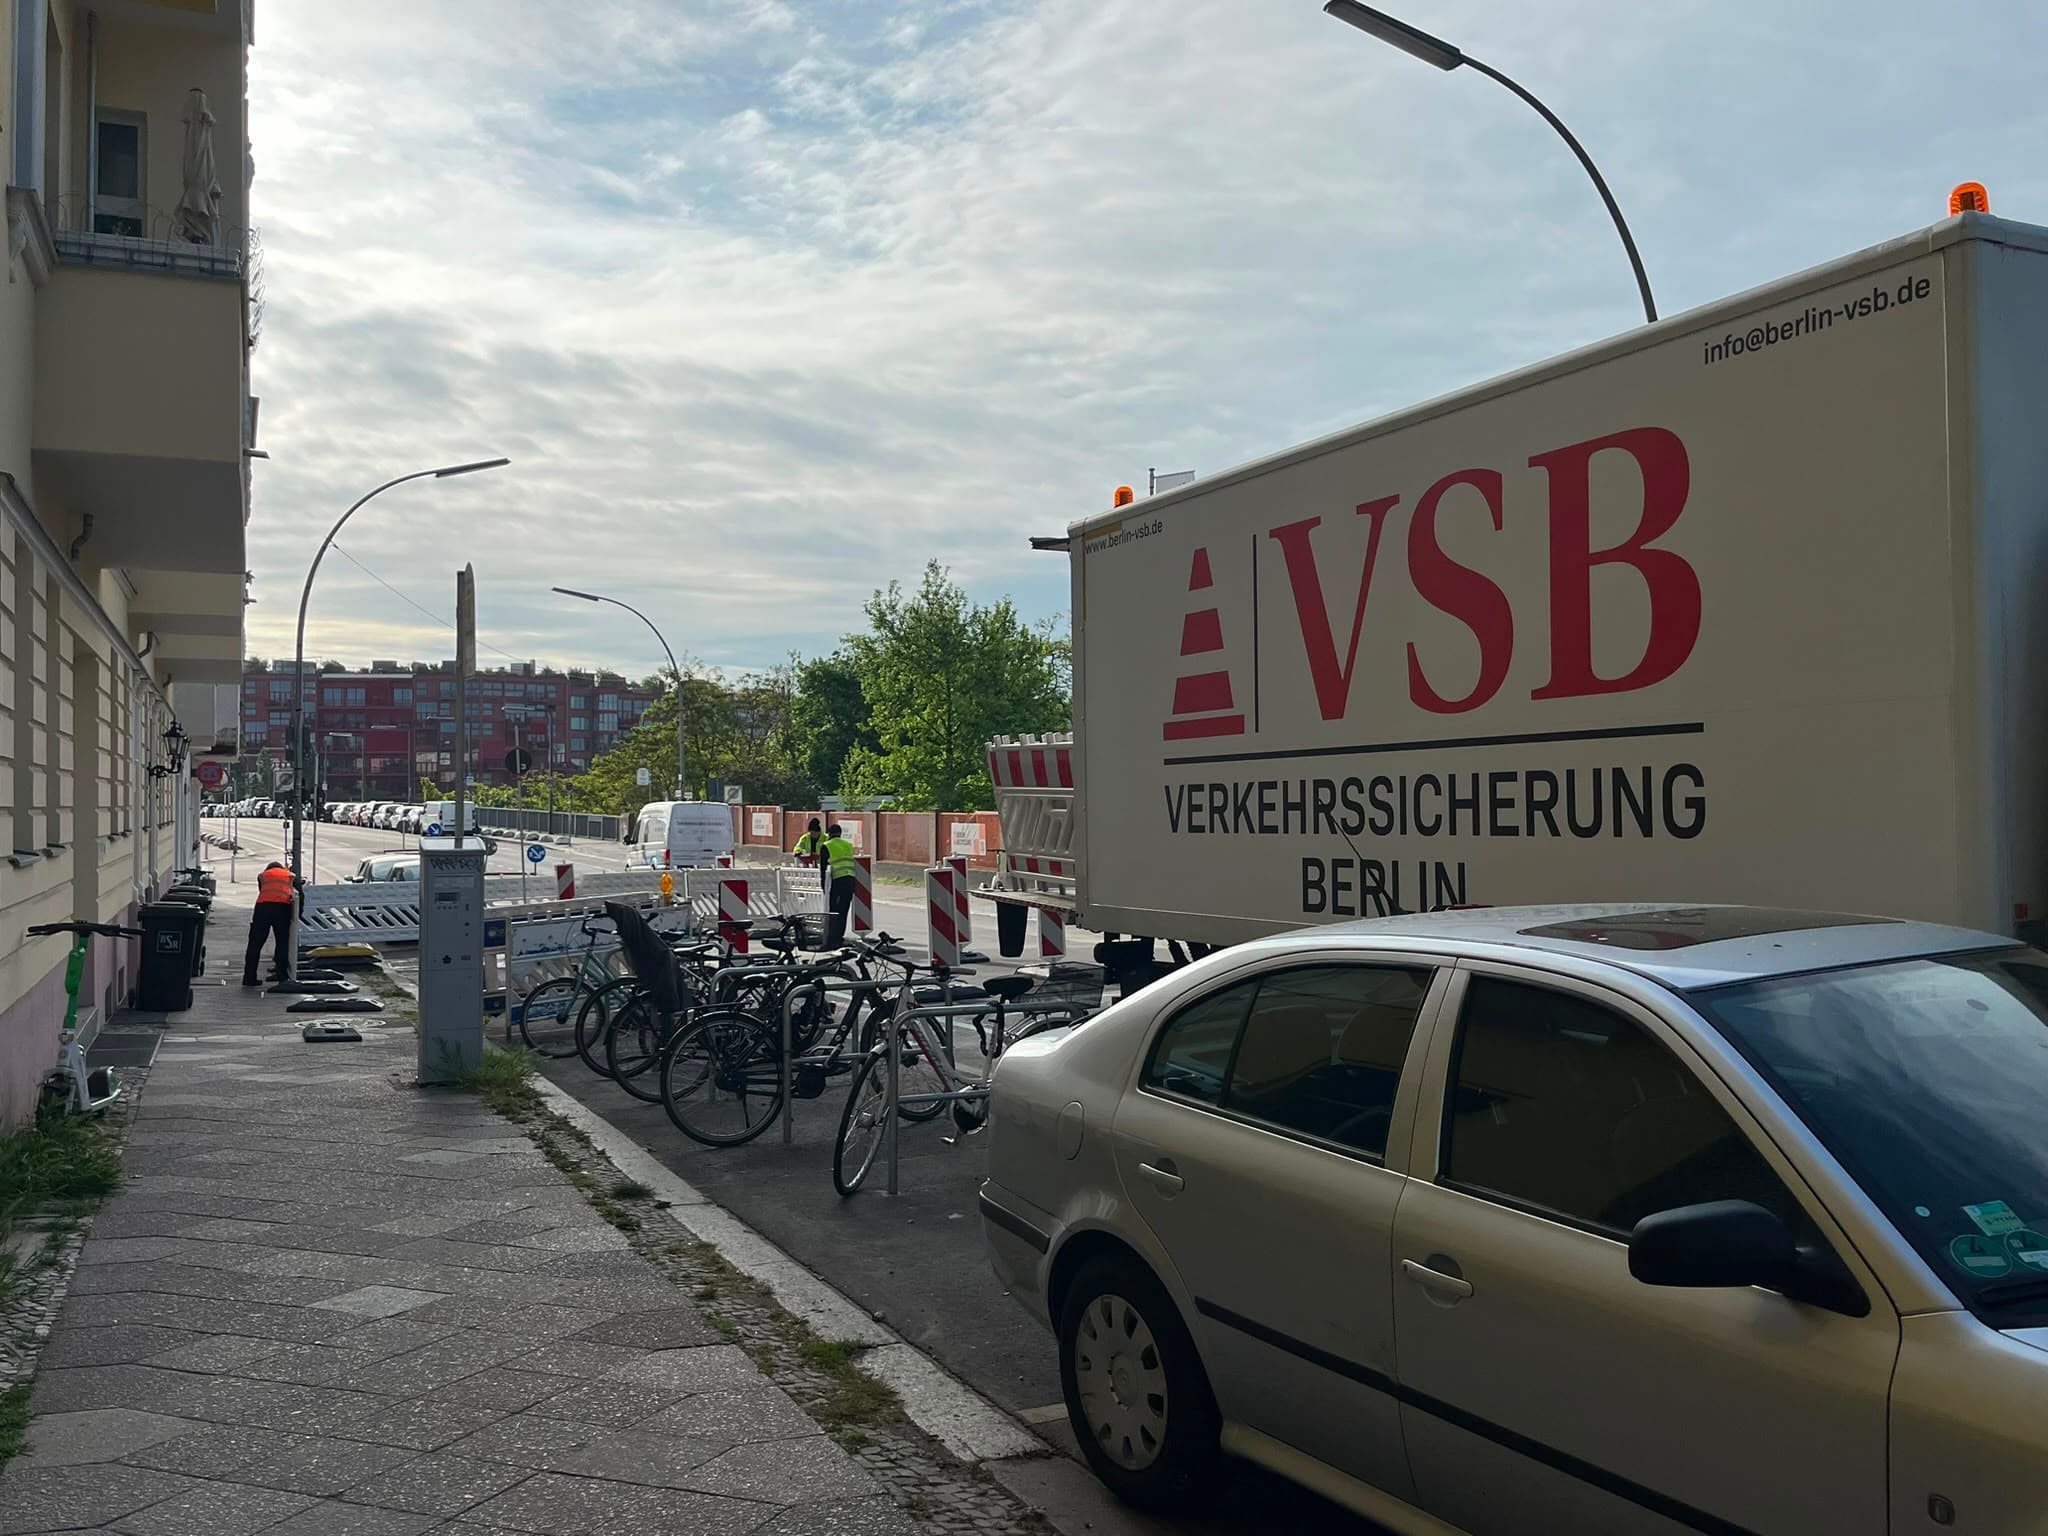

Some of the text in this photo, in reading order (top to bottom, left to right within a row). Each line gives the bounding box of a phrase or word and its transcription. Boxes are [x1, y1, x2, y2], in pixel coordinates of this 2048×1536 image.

[1703, 276, 1931, 365] info@berlin-vsb.de
[1085, 519, 1164, 555] www.berlin-vsb.de
[1268, 426, 1702, 721] VSB
[1164, 763, 1706, 839] VERKEHRSSICHERUNG
[1301, 857, 1466, 918] BERLIN
